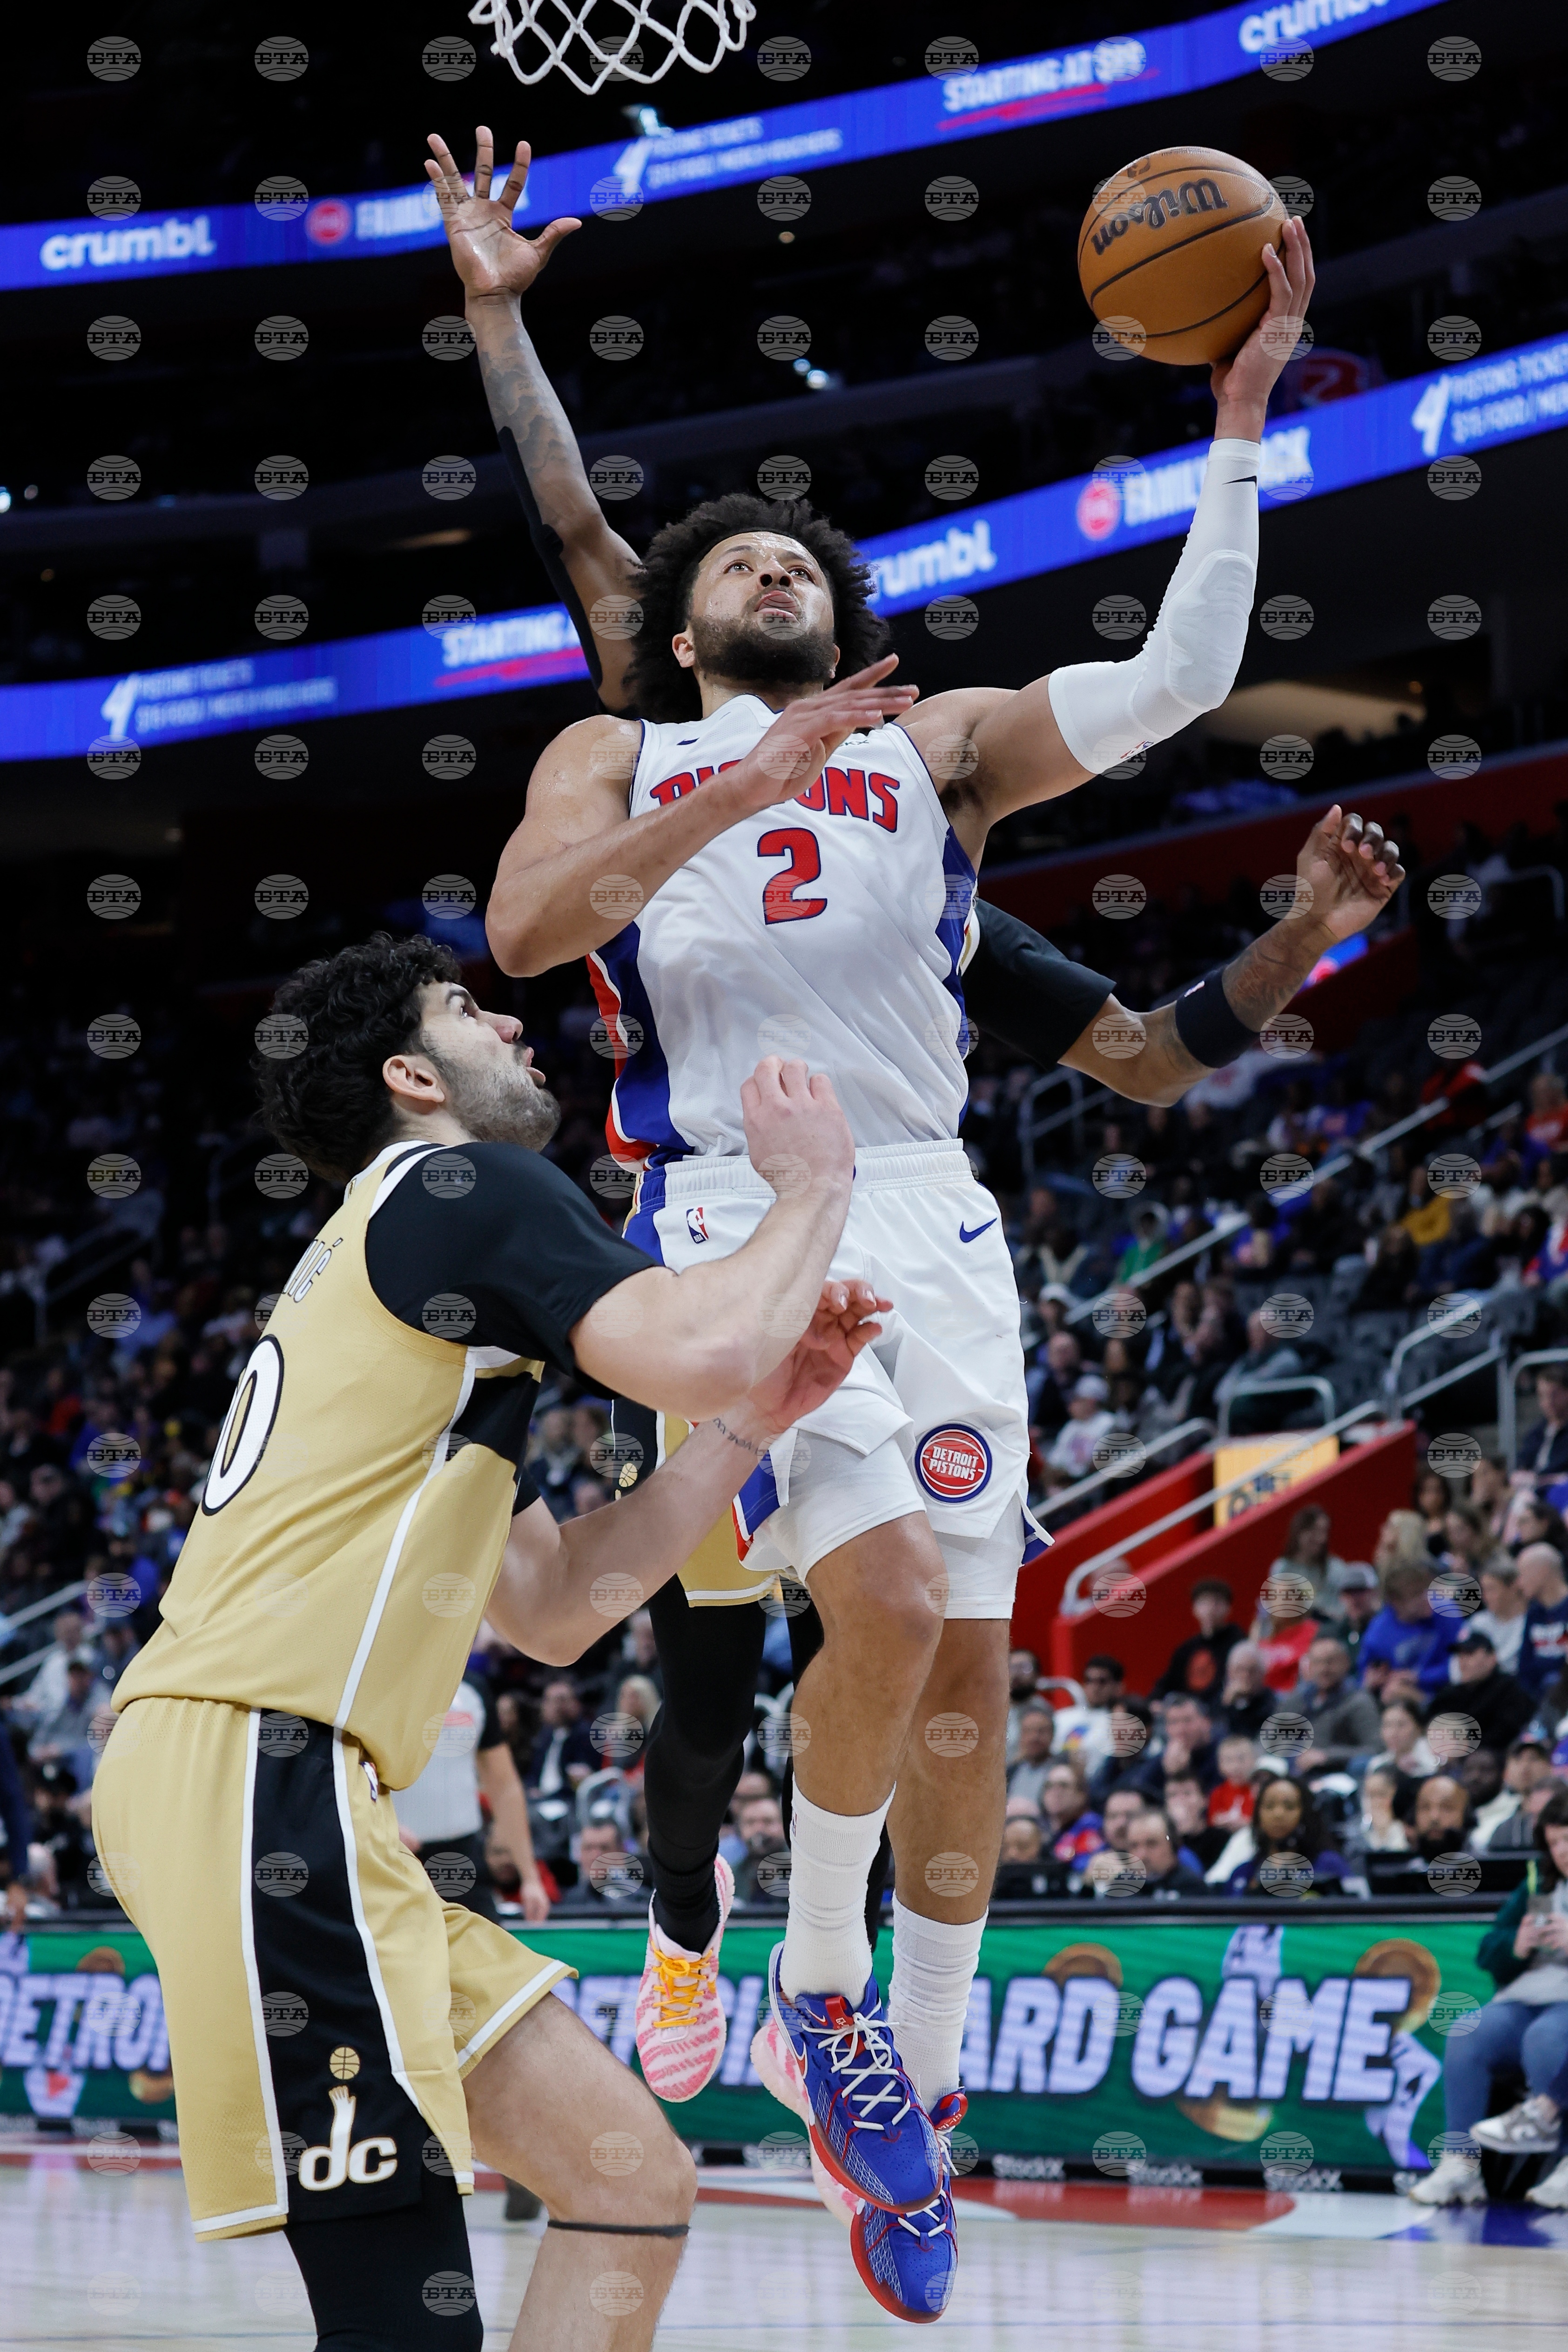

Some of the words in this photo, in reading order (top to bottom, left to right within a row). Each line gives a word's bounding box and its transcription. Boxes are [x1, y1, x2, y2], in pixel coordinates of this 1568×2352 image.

[1239, 0, 1388, 54] crum
[1090, 177, 1229, 256] Wilson
[866, 520, 997, 604] rumbl
[757, 827, 827, 925] 2
[929, 1459, 976, 1480] PISTONS
[933, 1446, 978, 1468] DETROIT
[959, 1976, 1119, 2094] ARD
[1131, 1976, 1411, 2101] GAME
